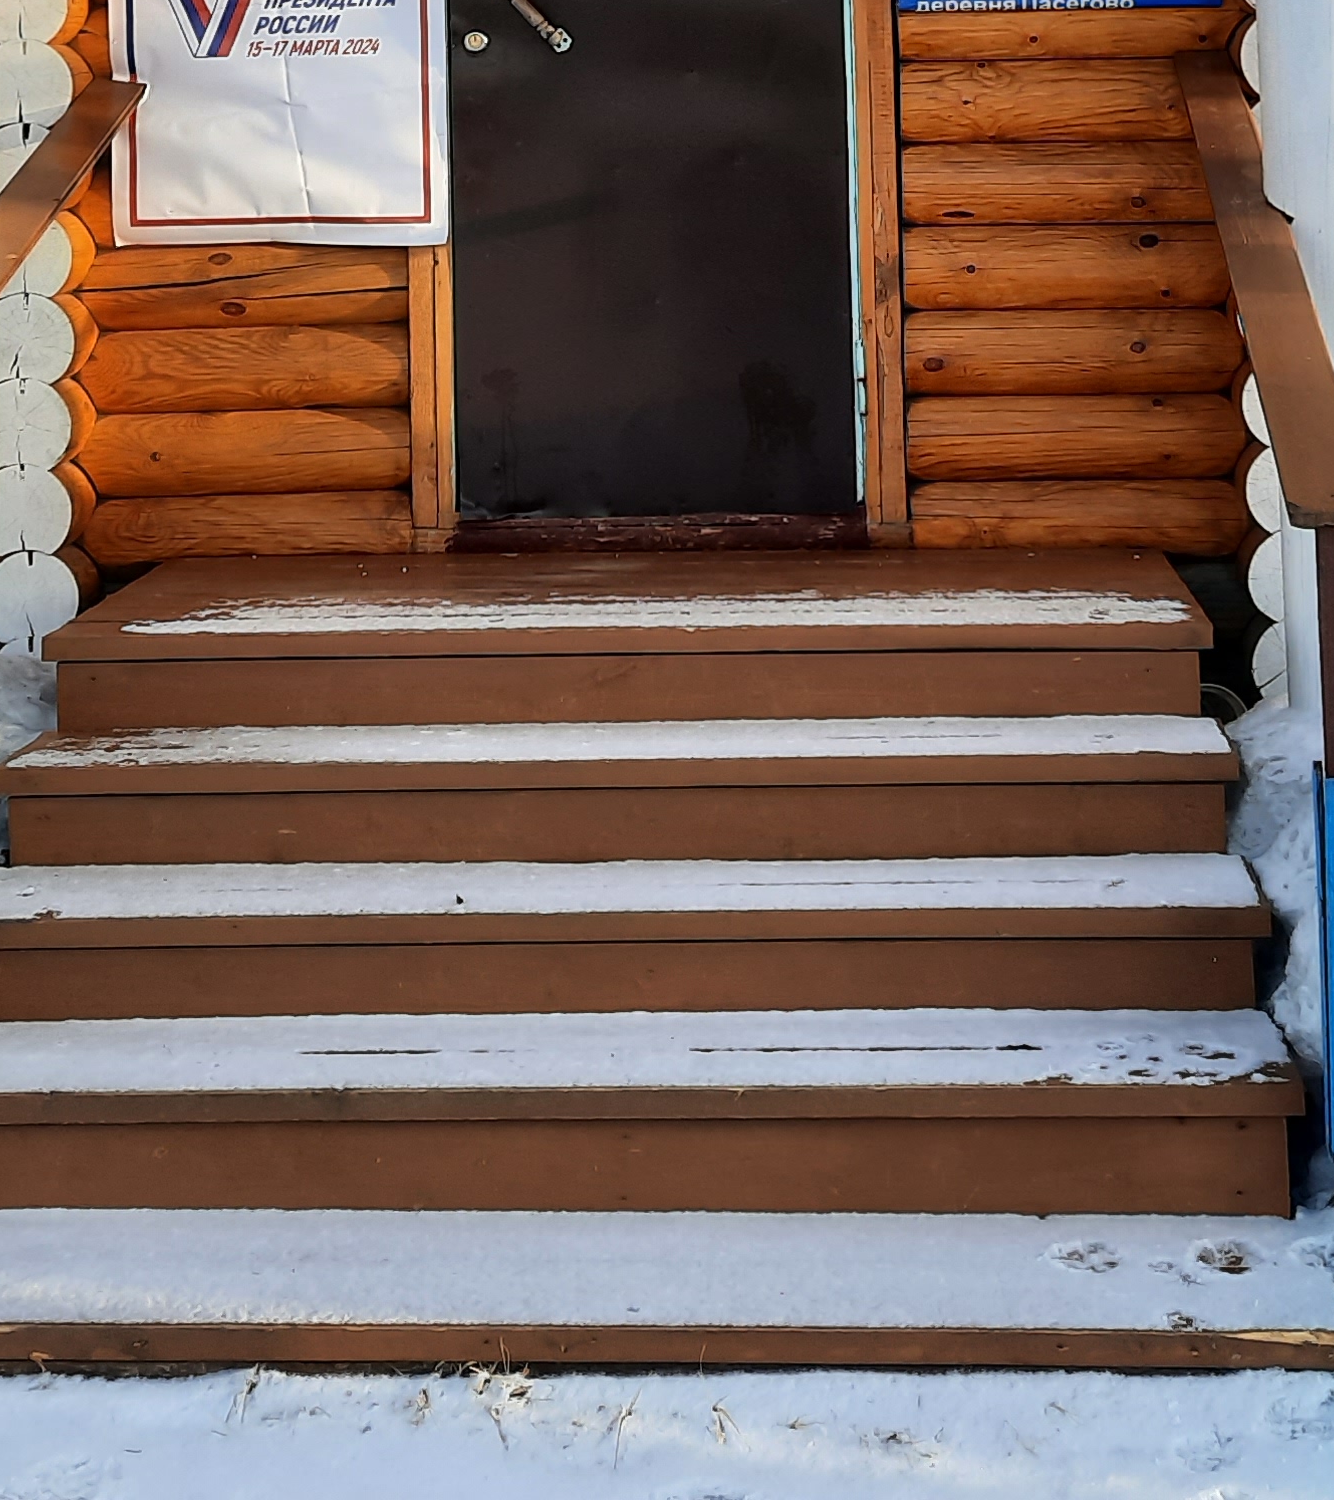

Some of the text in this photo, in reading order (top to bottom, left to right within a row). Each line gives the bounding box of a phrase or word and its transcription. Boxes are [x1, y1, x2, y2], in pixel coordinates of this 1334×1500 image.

[254, 15, 340, 35] РОССИИ
[291, 40, 340, 56] МАРТА
[343, 38, 380, 55] 2024
